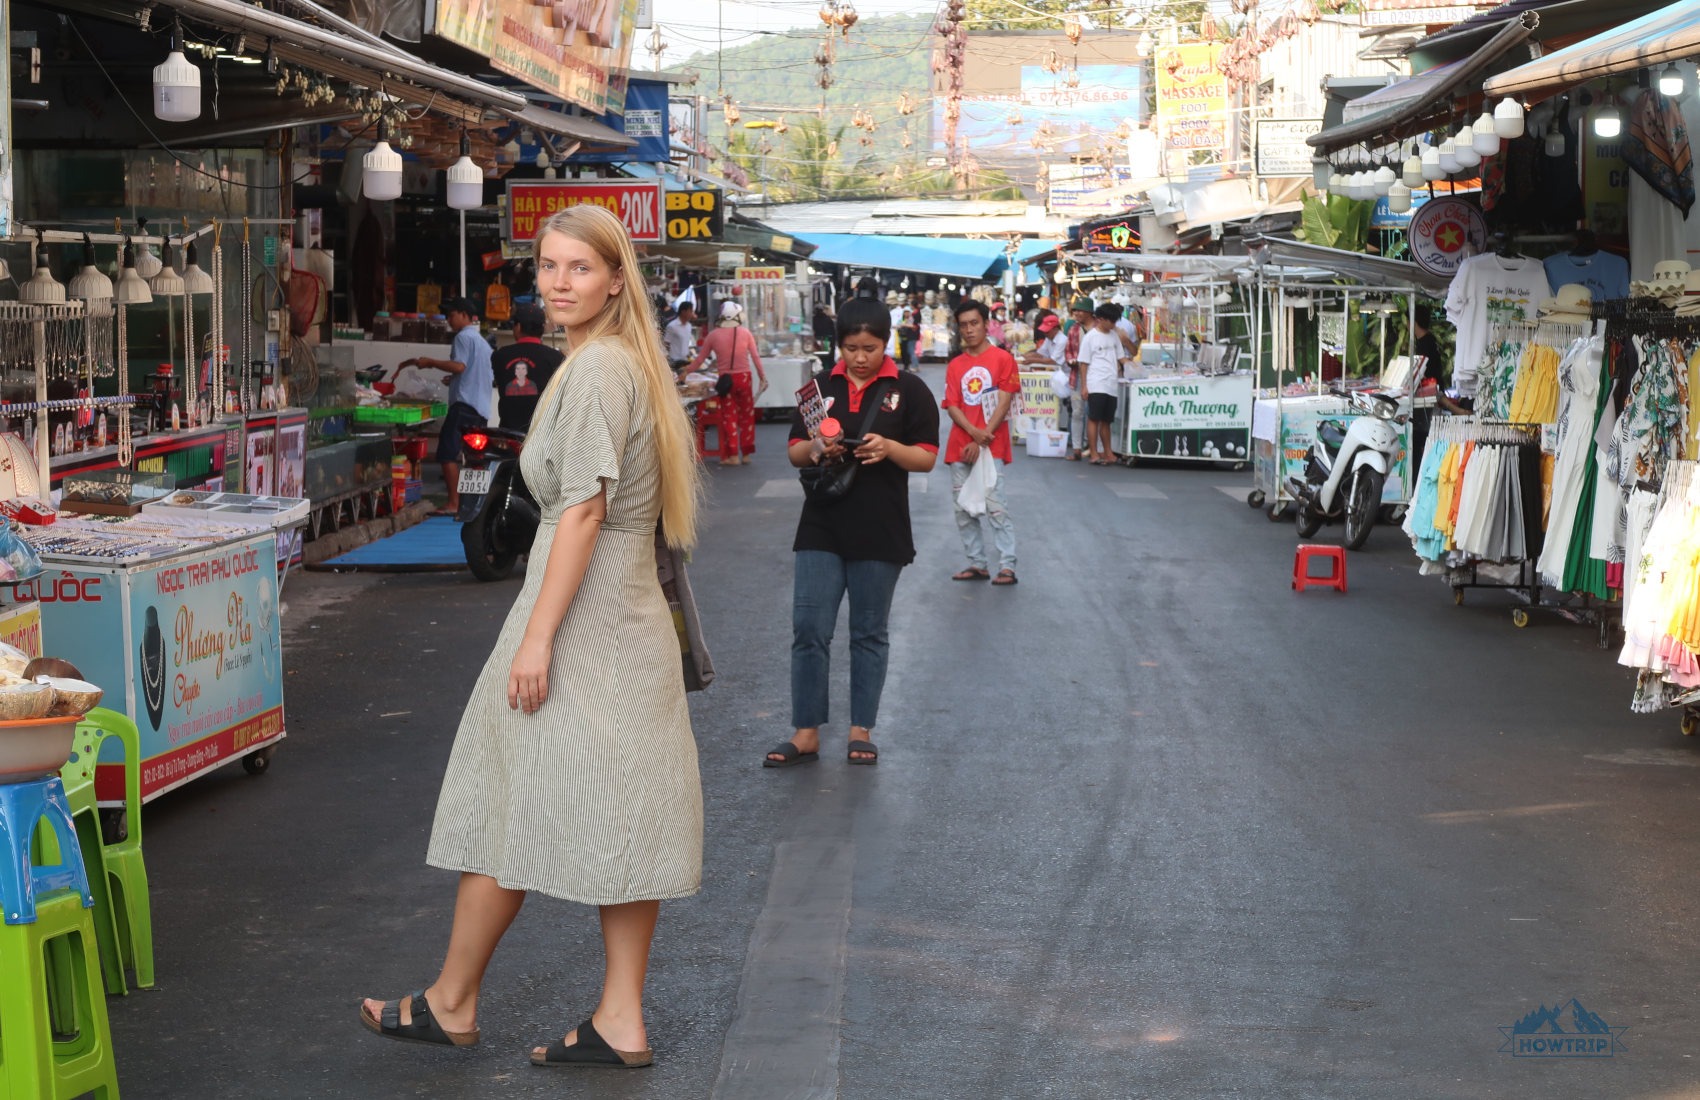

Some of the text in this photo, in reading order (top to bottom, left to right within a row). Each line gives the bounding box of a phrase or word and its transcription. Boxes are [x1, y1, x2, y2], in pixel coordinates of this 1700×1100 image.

[1428, 9, 1441, 21] 99
[1445, 9, 1457, 20] 18
[1461, 7, 1472, 19] 18
[1161, 85, 1223, 100] MASSAGE
[1181, 103, 1208, 113] FOOT
[1181, 119, 1210, 129] BODY
[514, 191, 542, 212] HẢI
[621, 191, 655, 235] 20K
[514, 216, 534, 236] TỰ
[1138, 385, 1199, 398] NGỌC TRAI
[459, 481, 487, 492] 330.54
[157, 567, 185, 597] NGỌC
[187, 560, 209, 588] TRAI
[211, 551, 231, 582] PHÚ
[233, 545, 259, 578] QUỐC
[13, 570, 102, 602] QUỐC
